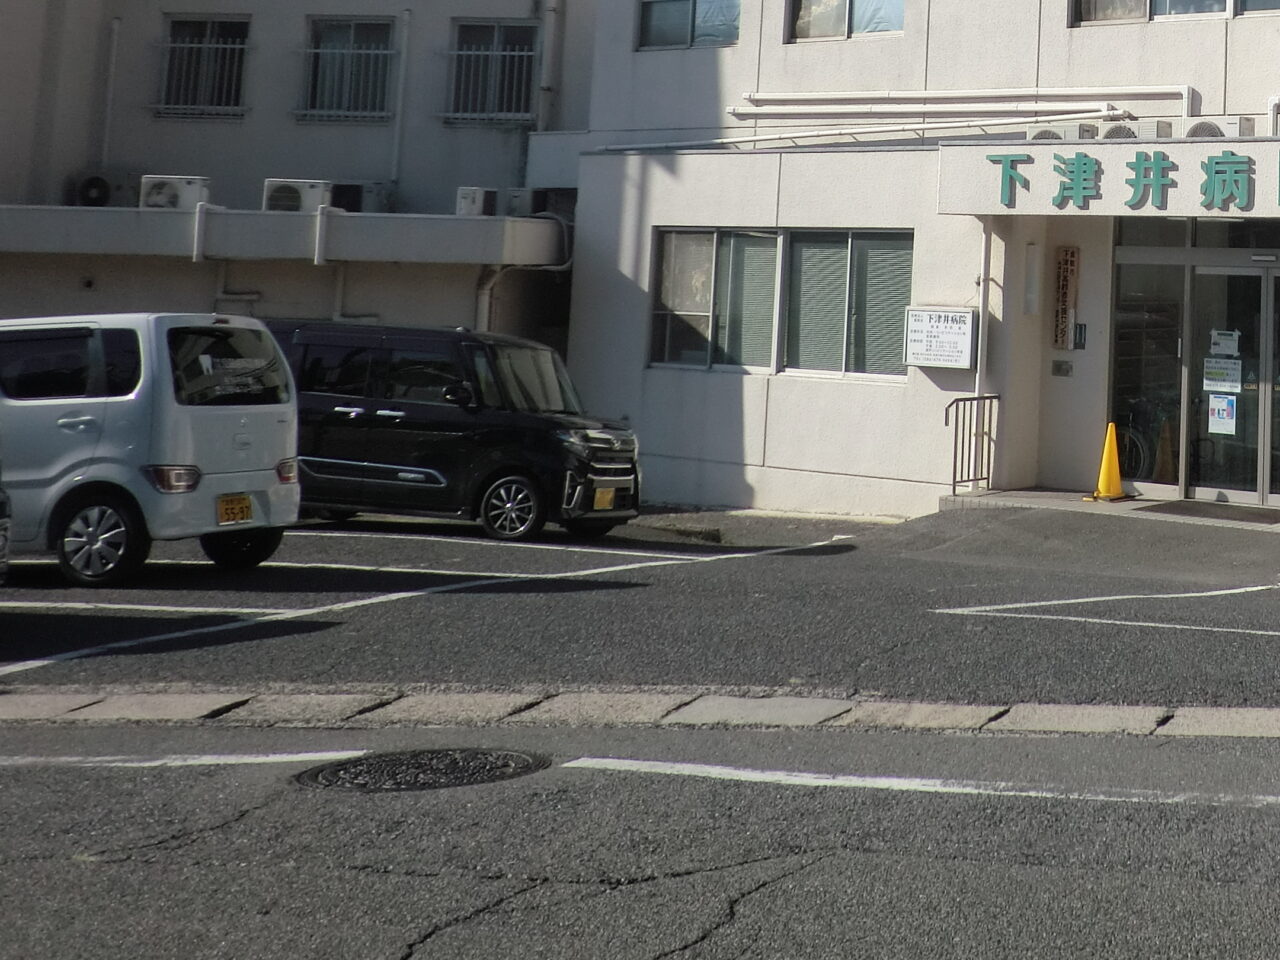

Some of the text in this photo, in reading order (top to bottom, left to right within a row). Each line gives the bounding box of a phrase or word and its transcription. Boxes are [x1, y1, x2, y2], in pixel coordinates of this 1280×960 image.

[927, 313, 967, 326] 下津井病院
